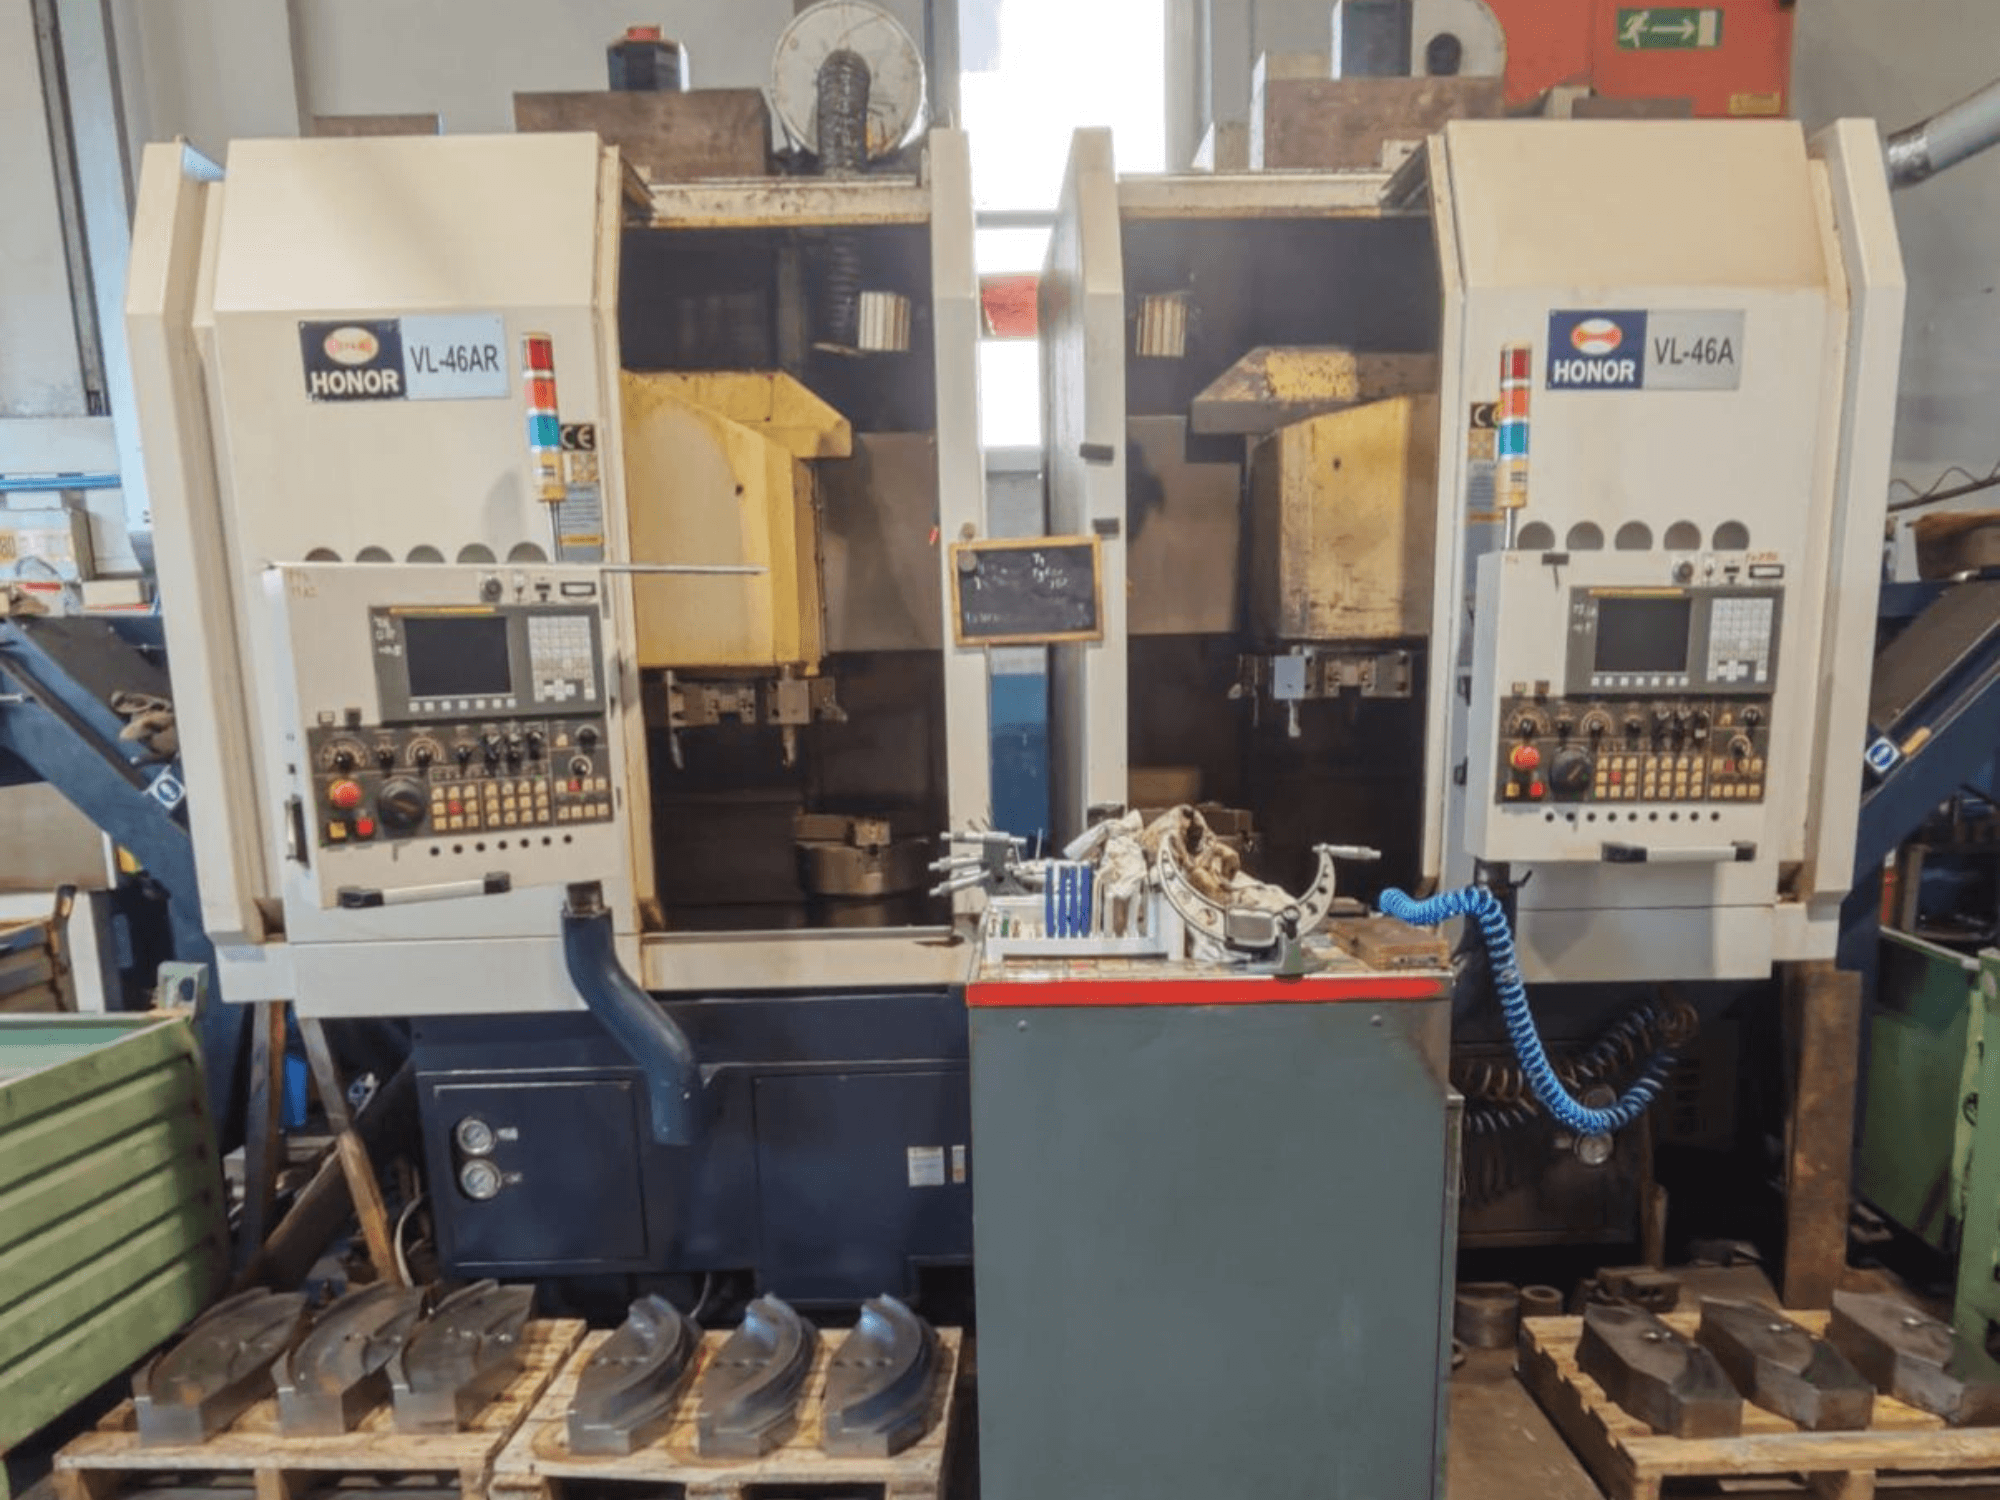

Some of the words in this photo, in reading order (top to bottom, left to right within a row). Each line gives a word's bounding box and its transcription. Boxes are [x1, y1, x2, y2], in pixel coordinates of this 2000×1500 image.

[409, 343, 500, 374] VL-46AR
[1654, 337, 1734, 365] VL-46A
[310, 369, 399, 394] HONOR
[1553, 359, 1636, 383] HONOR
